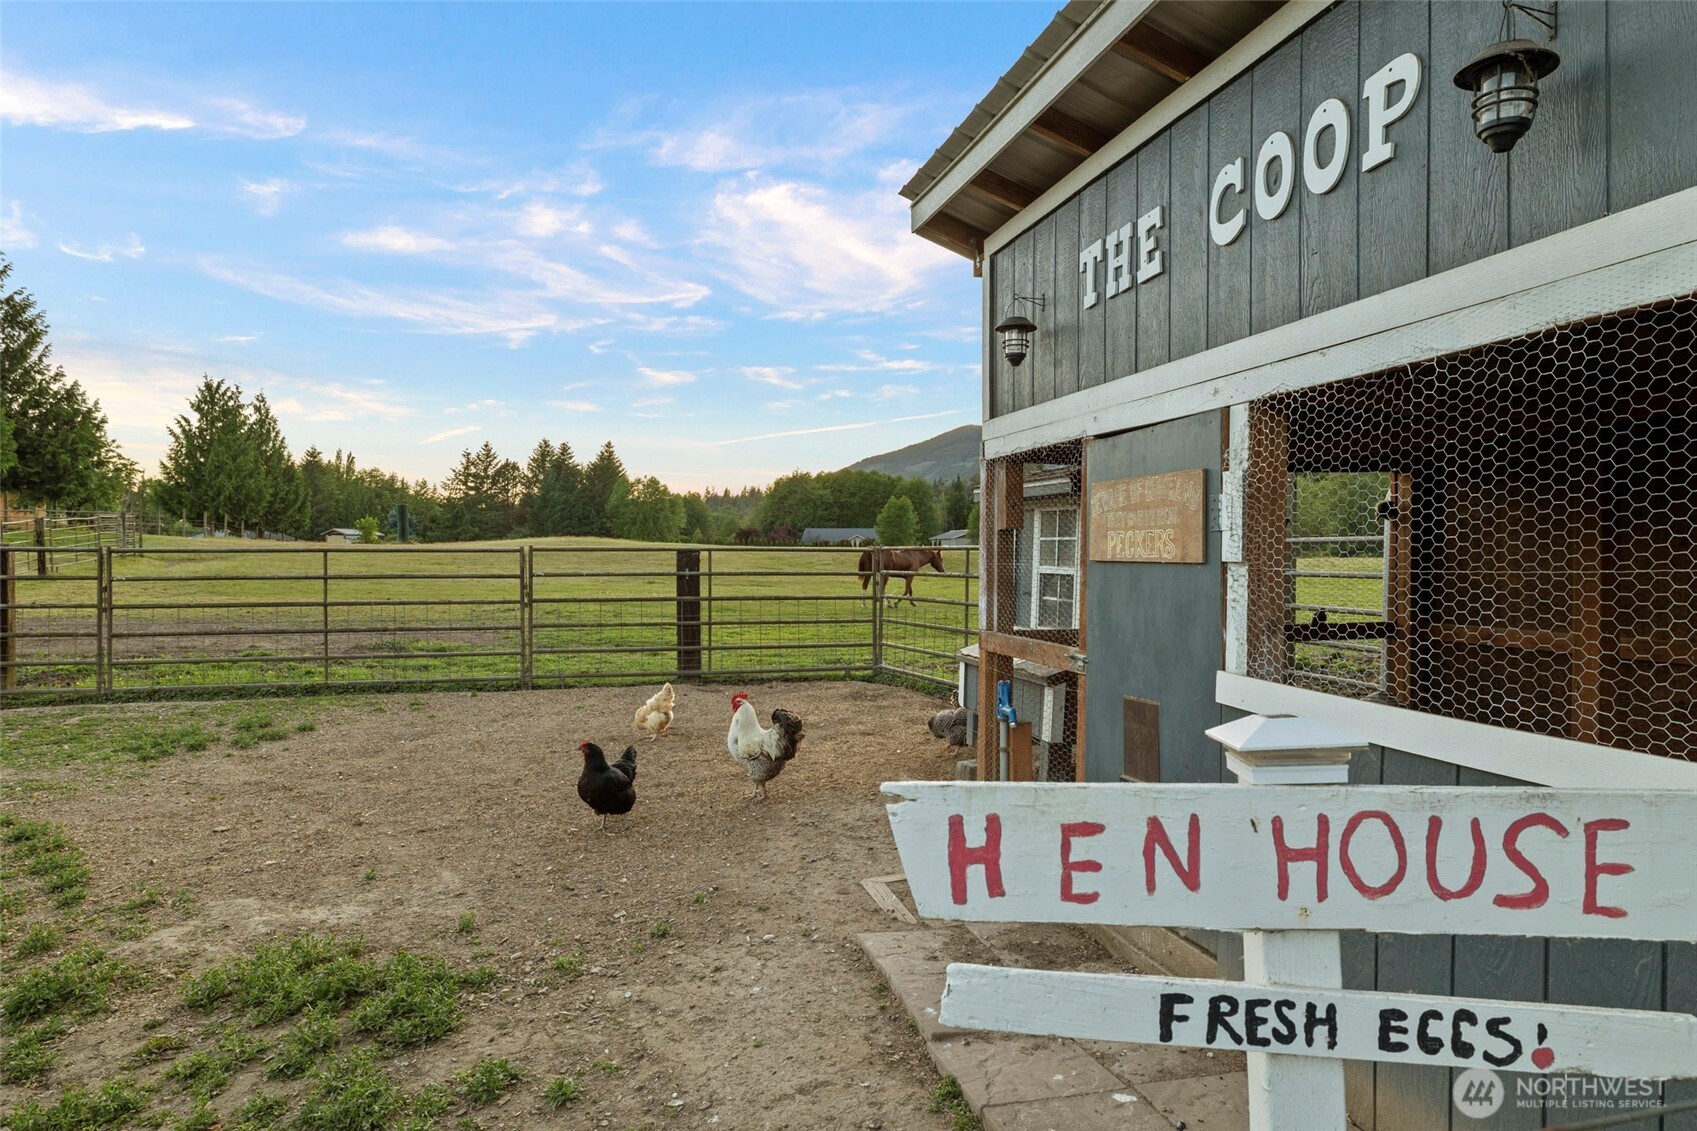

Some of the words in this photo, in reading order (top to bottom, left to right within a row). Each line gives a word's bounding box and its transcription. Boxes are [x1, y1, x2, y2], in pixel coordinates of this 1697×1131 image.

[1079, 206, 1163, 310] THE
[1209, 53, 1422, 246] COOP
[1107, 528, 1176, 559] PECKERS
[948, 813, 1201, 905] HEN
[1271, 810, 1635, 918] HOUSE
[1159, 993, 1338, 1050] FRESH
[1378, 1008, 1555, 1069] EGGS!
